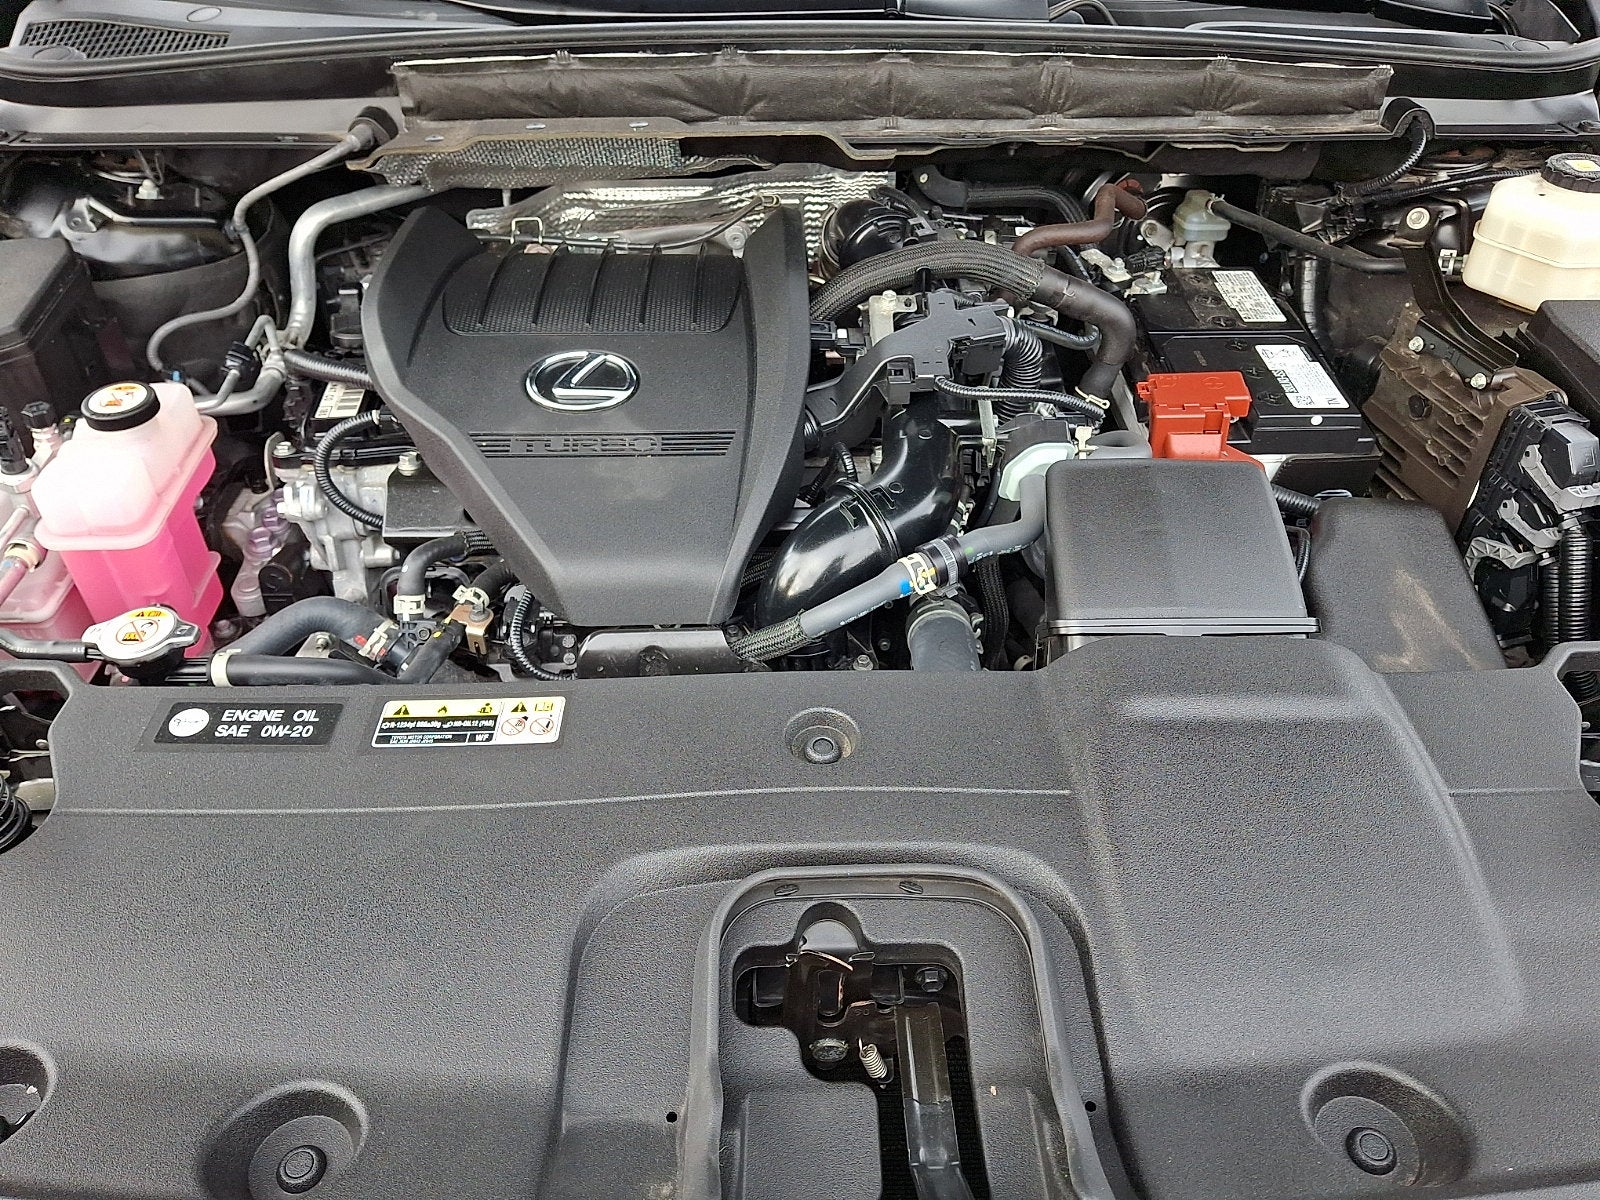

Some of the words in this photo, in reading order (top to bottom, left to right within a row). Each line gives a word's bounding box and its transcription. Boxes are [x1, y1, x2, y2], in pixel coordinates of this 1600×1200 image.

[510, 436, 659, 453] TURBO
[221, 709, 285, 722] ENGINE
[292, 709, 320, 722] OIL
[214, 725, 251, 738] SAE
[260, 725, 314, 738] 0W-20
[475, 734, 489, 742] WF
